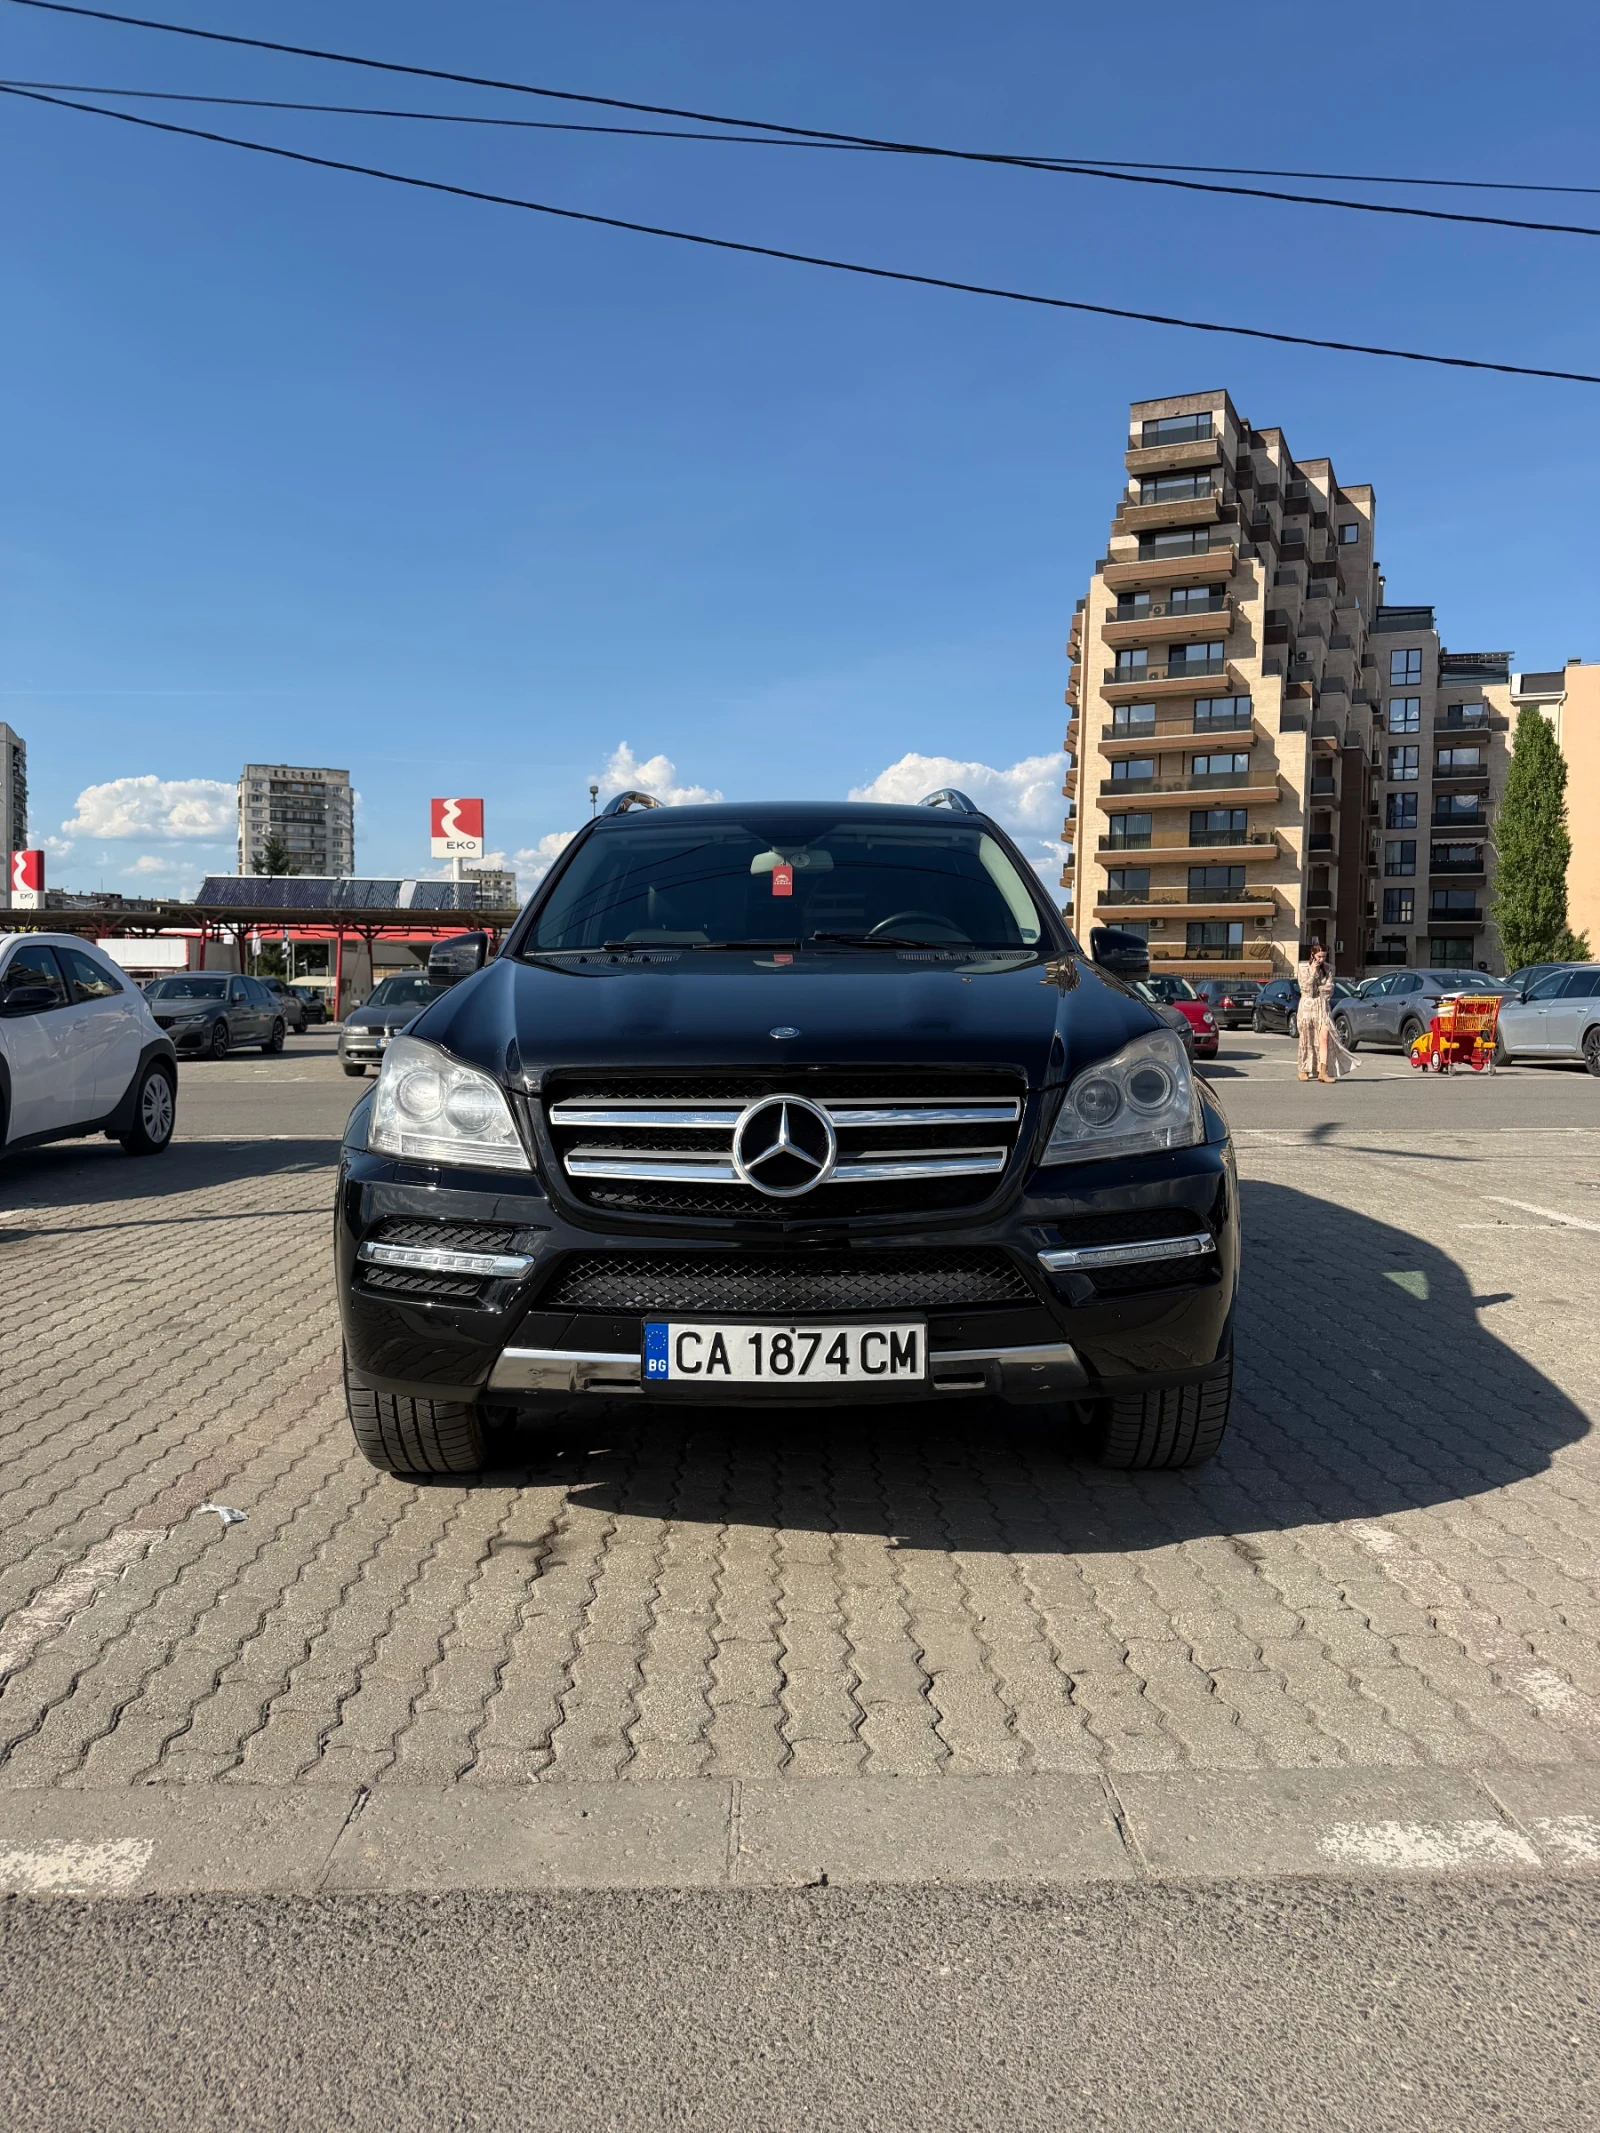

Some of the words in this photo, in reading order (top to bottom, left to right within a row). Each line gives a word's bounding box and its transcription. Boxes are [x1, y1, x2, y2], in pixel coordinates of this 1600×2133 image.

[446, 841, 476, 849] EKO
[675, 1331, 732, 1375] CA
[747, 1332, 850, 1376] 1874
[859, 1330, 917, 1374] CM
[648, 1359, 667, 1373] BG
